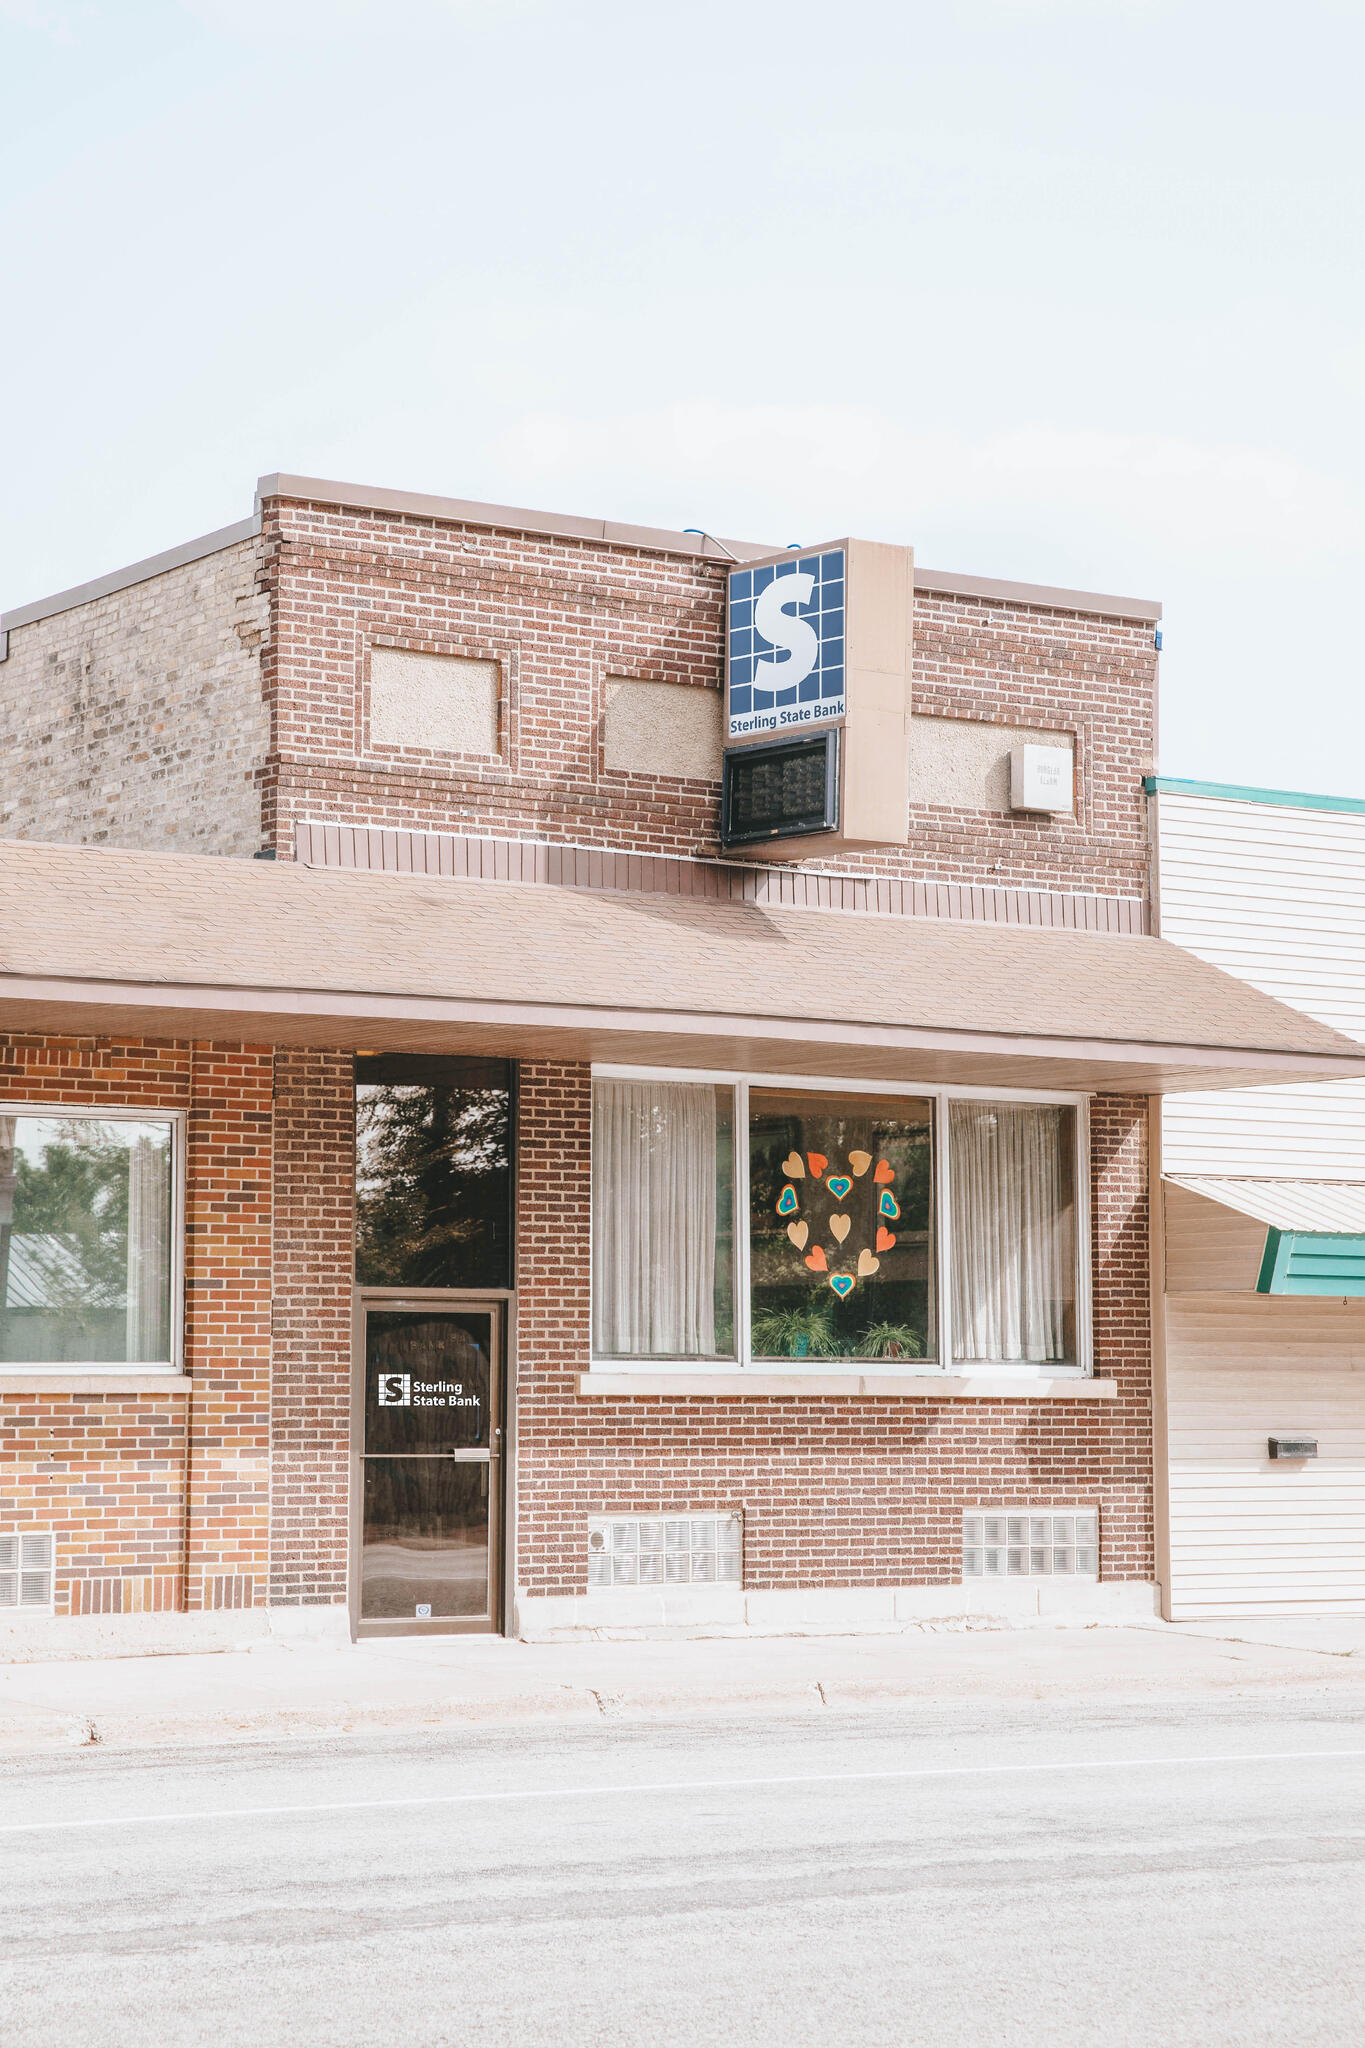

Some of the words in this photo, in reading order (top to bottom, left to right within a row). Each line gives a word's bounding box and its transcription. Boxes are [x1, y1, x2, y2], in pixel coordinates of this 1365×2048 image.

[752, 573, 818, 692] S
[730, 716, 777, 733] Sterling
[780, 710, 811, 724] State
[814, 701, 845, 718] Bank
[385, 1377, 403, 1402] S
[413, 1381, 463, 1395] Sterling
[413, 1395, 446, 1406] State
[449, 1395, 480, 1406] Bank
